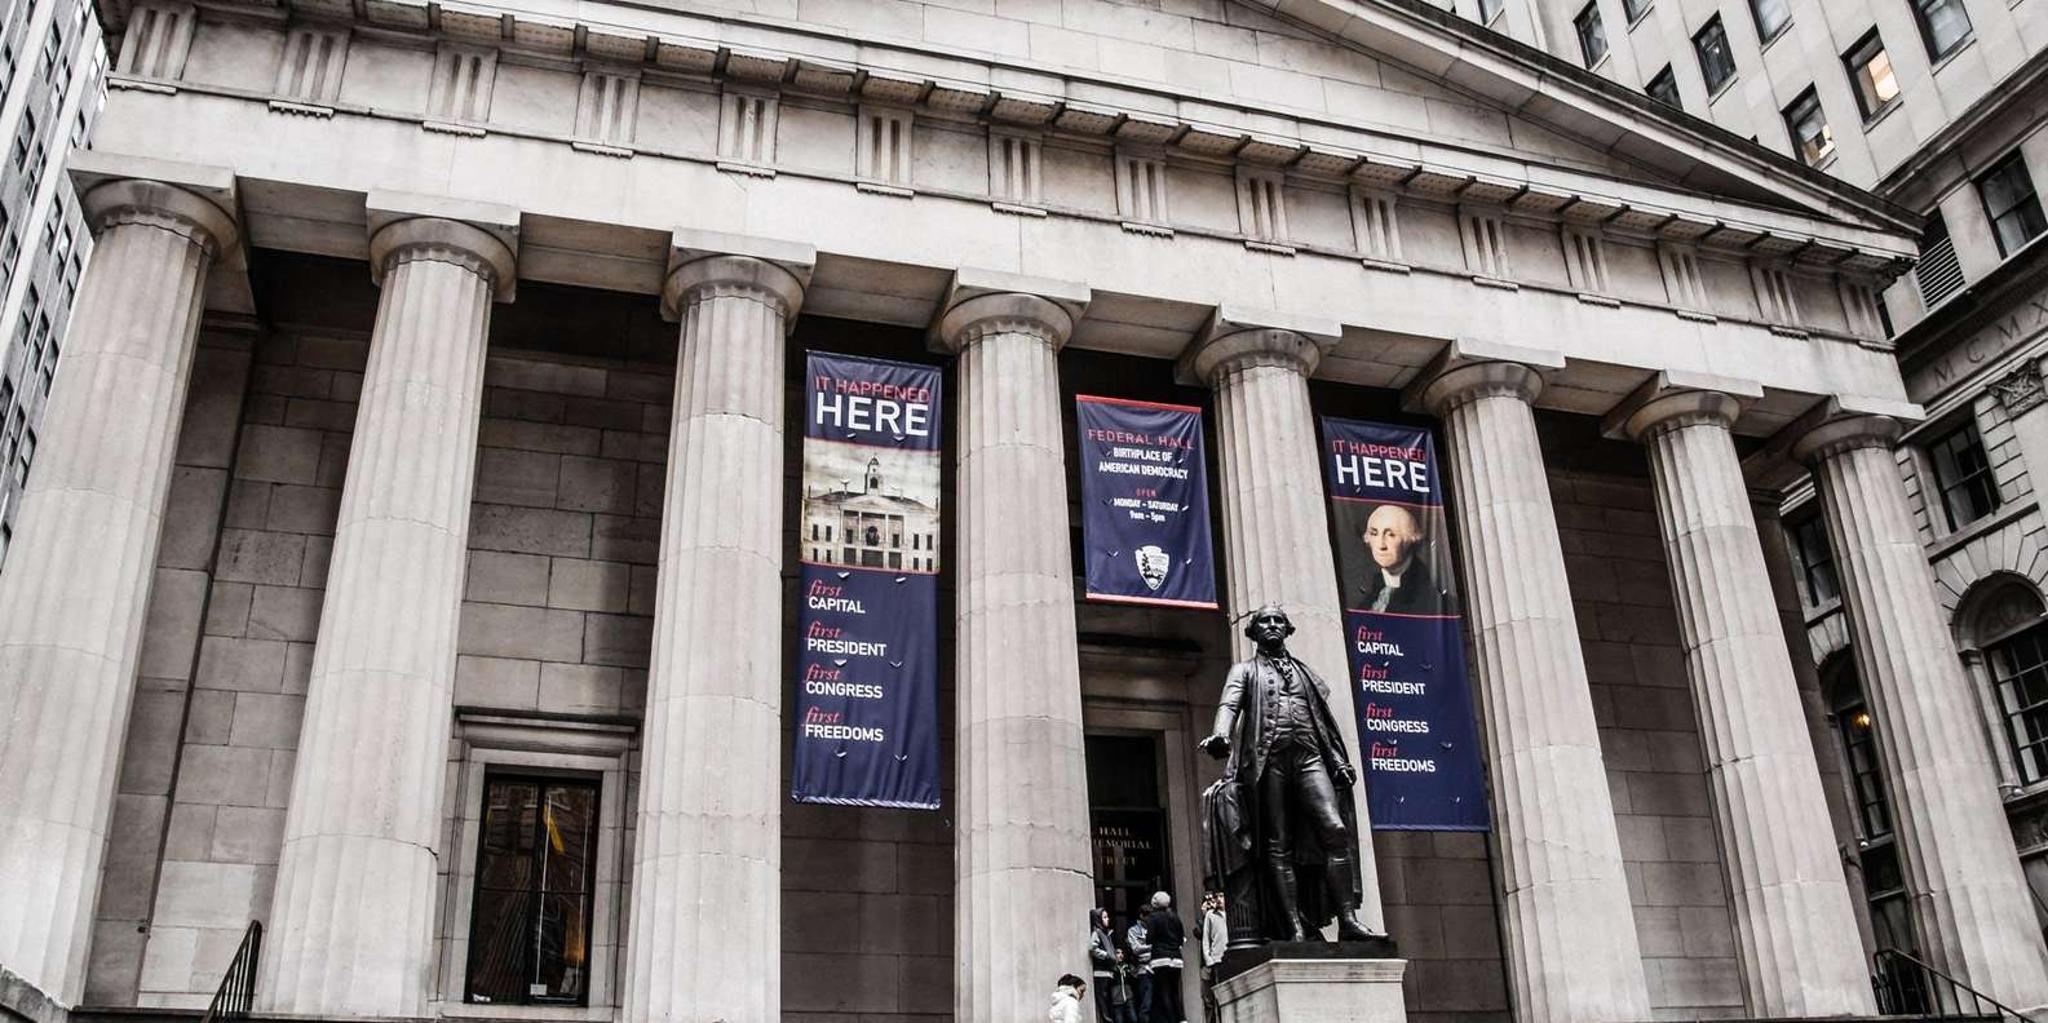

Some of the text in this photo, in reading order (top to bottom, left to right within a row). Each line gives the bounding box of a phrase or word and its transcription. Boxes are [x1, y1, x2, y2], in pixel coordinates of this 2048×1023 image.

[815, 376, 931, 403] IT HAPPENED
[816, 392, 929, 436] HERE
[1088, 428, 1194, 450] FEDERAL HALL
[1113, 447, 1173, 462] BIRTHPLACE OF
[1333, 439, 1426, 462] IT HAPPENED
[1099, 461, 1188, 479] AMERICAN DEMOCRACY
[1335, 454, 1430, 493] HERE
[1113, 498, 1141, 508] MONDAY
[1147, 500, 1179, 512] SATURDAY
[805, 579, 843, 598] first
[808, 597, 866, 614] CAPITAL
[804, 620, 842, 640] first
[1356, 625, 1383, 643] first
[807, 638, 887, 657] PRESIDENT
[1357, 641, 1404, 656] CAPITAL
[804, 663, 841, 683] first
[1361, 664, 1388, 681] first
[805, 681, 883, 699] CONGRESS
[1362, 679, 1426, 695] PRESIDENT
[802, 706, 840, 726] first
[1365, 702, 1393, 719] first
[805, 724, 884, 742] FREEDOMS
[1367, 719, 1430, 734] CONGRESS
[1370, 741, 1398, 759] first
[1372, 758, 1436, 773] FREEDOMS
[1099, 826, 1130, 836] HALL
